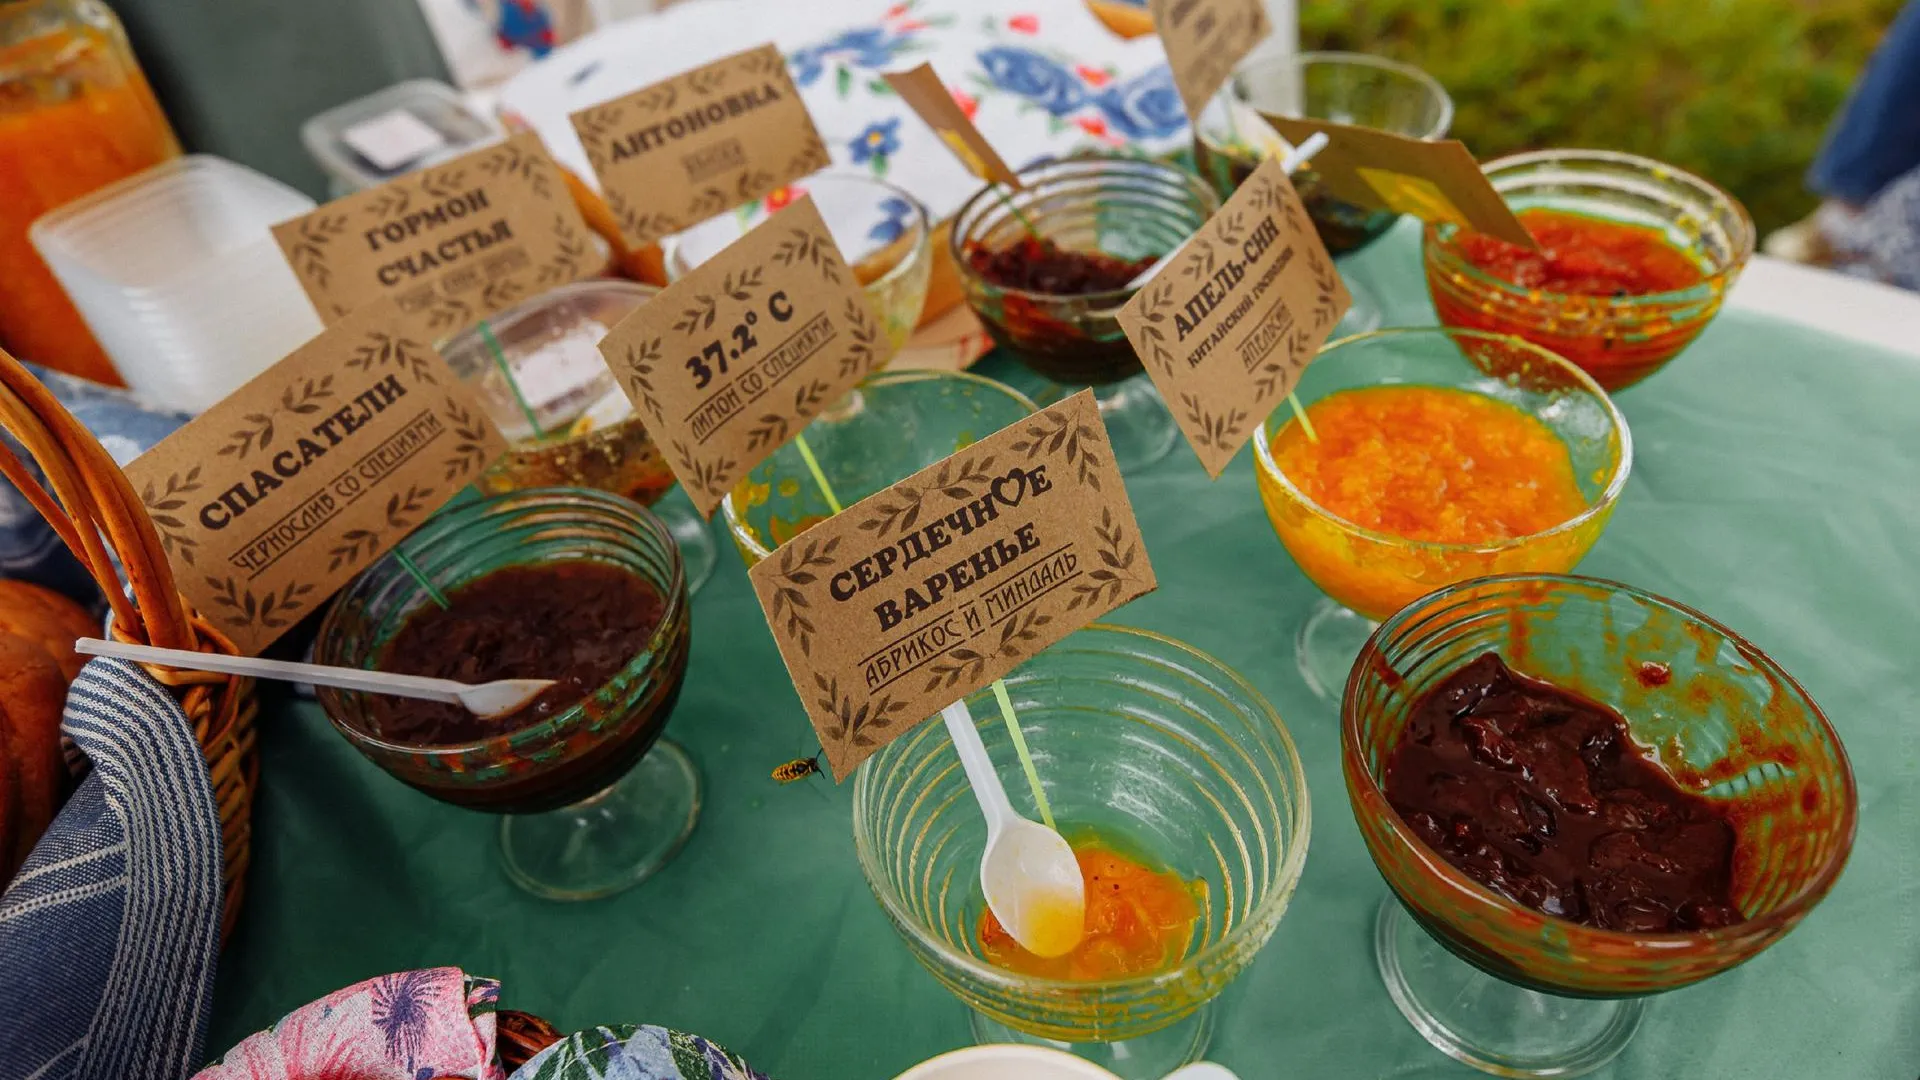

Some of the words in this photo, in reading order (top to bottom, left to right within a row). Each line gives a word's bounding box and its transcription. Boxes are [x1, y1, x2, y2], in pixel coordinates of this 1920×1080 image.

[611, 83, 780, 164] АНТОНОВКА
[364, 187, 490, 251] ГОРМОН
[377, 218, 514, 286] СЧАСТЬЯ
[1174, 215, 1280, 342] АПЕЛЬ-СИН
[1187, 293, 1254, 368] КИТАЙСКИЙ
[690, 387, 742, 440] ЛИМОН
[740, 373, 764, 396] СО
[762, 317, 835, 379] СПЕЦИЯМИ
[199, 373, 408, 531] СПАСАТЕЛИ
[233, 493, 337, 572] ЧЕРНОСЛИВ
[335, 475, 361, 497] СО
[359, 413, 443, 482] СПЕЦИЯМИ
[865, 617, 962, 689] АБРИКОС
[962, 606, 981, 632] И
[984, 552, 1078, 620] МИНДАЛЬ
[873, 522, 1041, 633] ВАРЕНЬЕ
